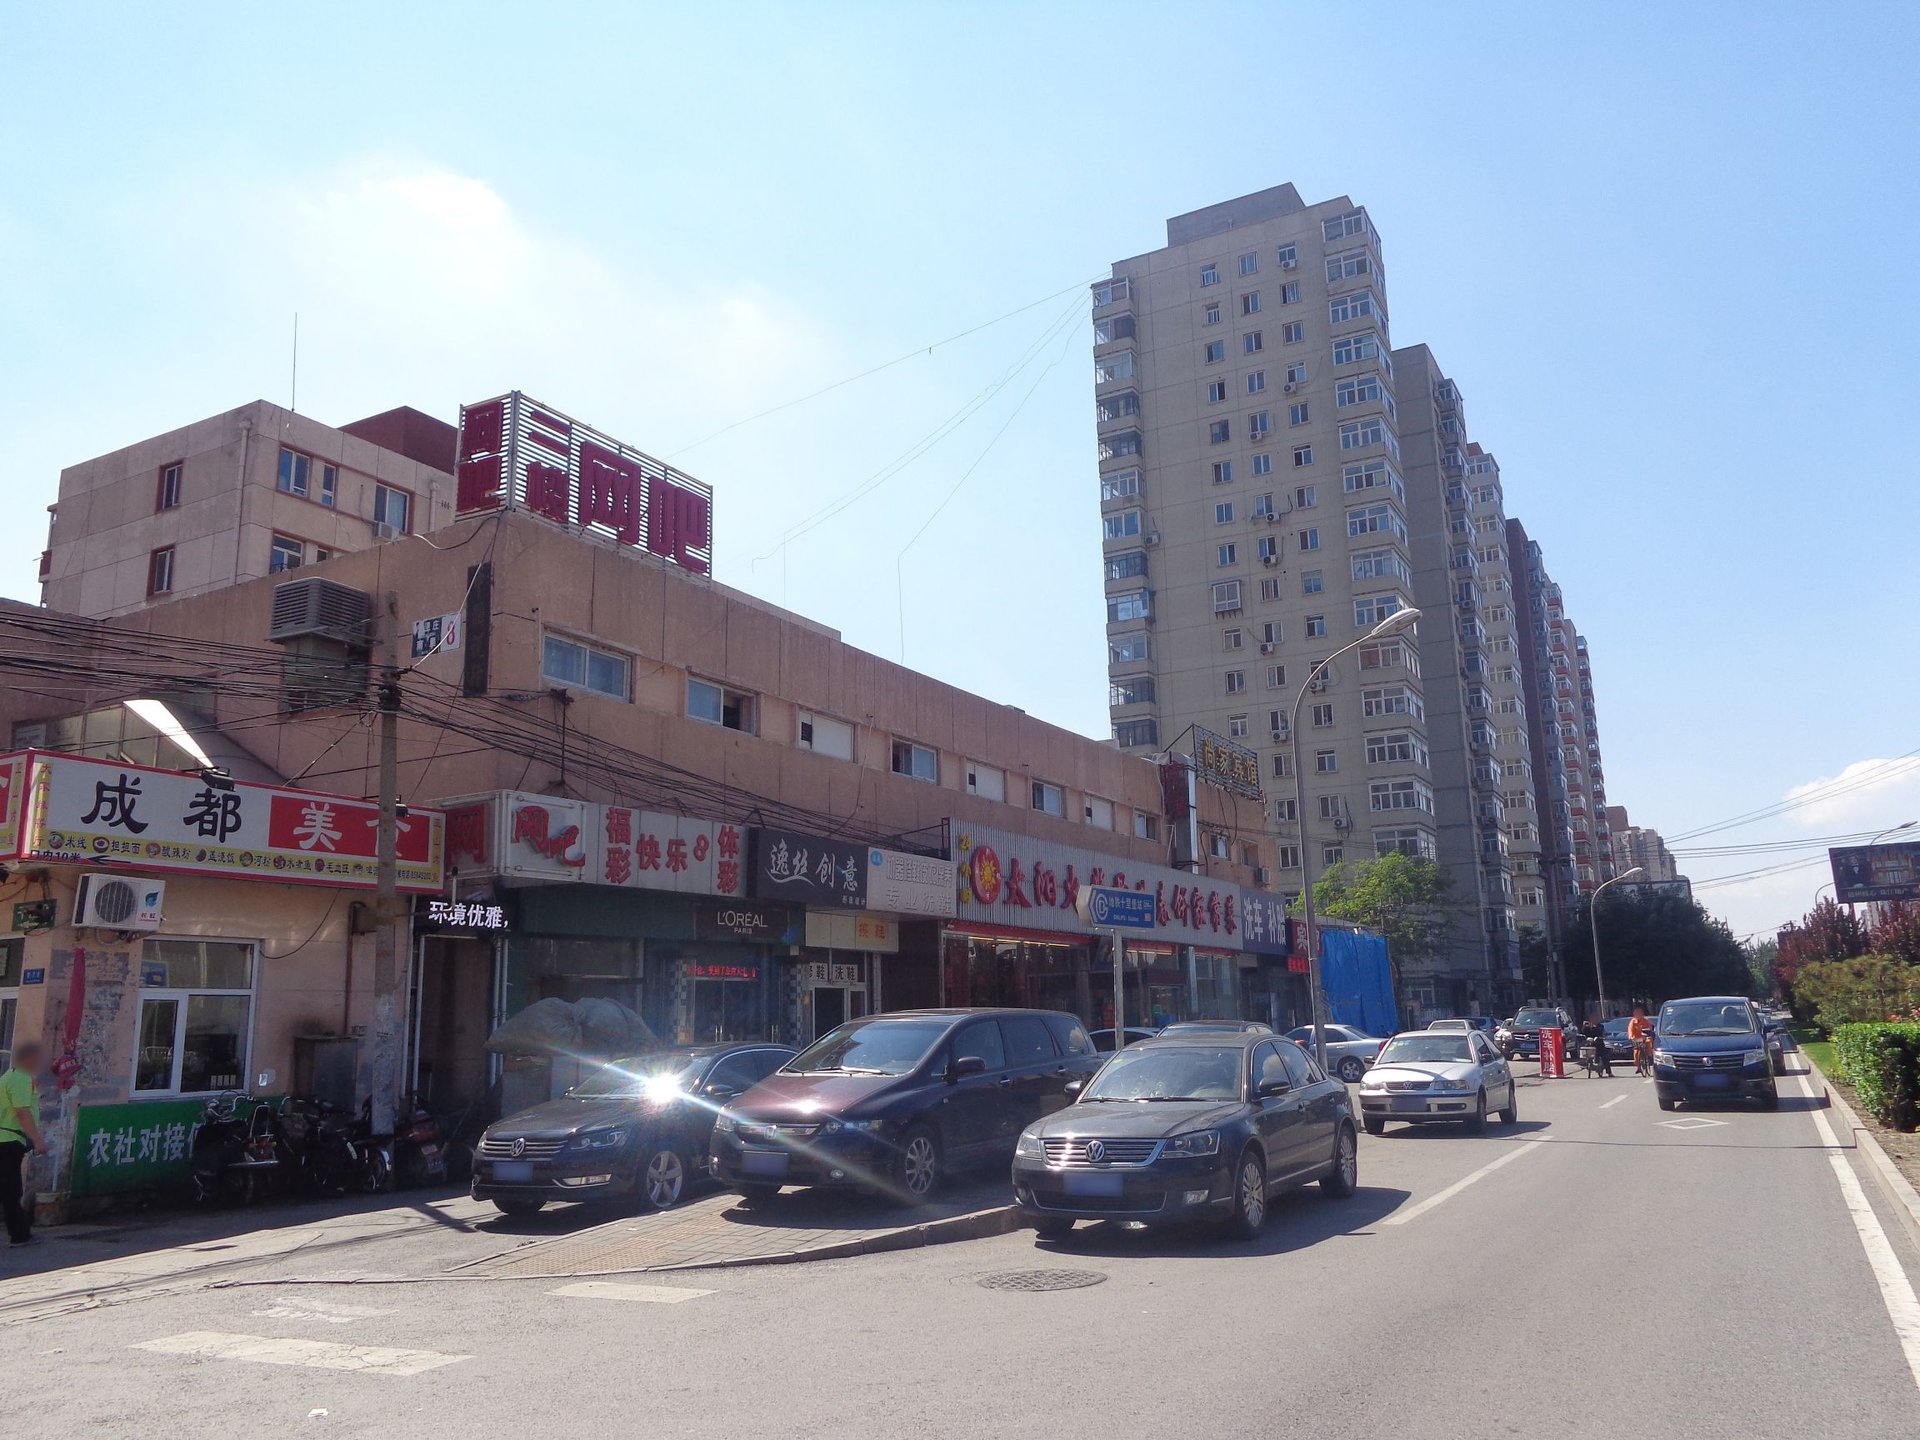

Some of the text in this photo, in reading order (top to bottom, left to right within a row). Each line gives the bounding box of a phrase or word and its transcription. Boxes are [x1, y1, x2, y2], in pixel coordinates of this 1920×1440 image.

[81, 773, 242, 843] 成都
[111, 840, 141, 854] 担担面
[511, 805, 586, 867] 网吧
[605, 807, 632, 884] 福彩
[636, 833, 710, 873] 快乐8
[717, 824, 740, 894] 体彩
[765, 838, 858, 892] 逸丝创意
[717, 910, 768, 928] L'ORÉAL
[733, 927, 753, 935] PARIS
[1243, 897, 1286, 946] 洗车 补胎
[1541, 1029, 1555, 1072] 洗车补胎
